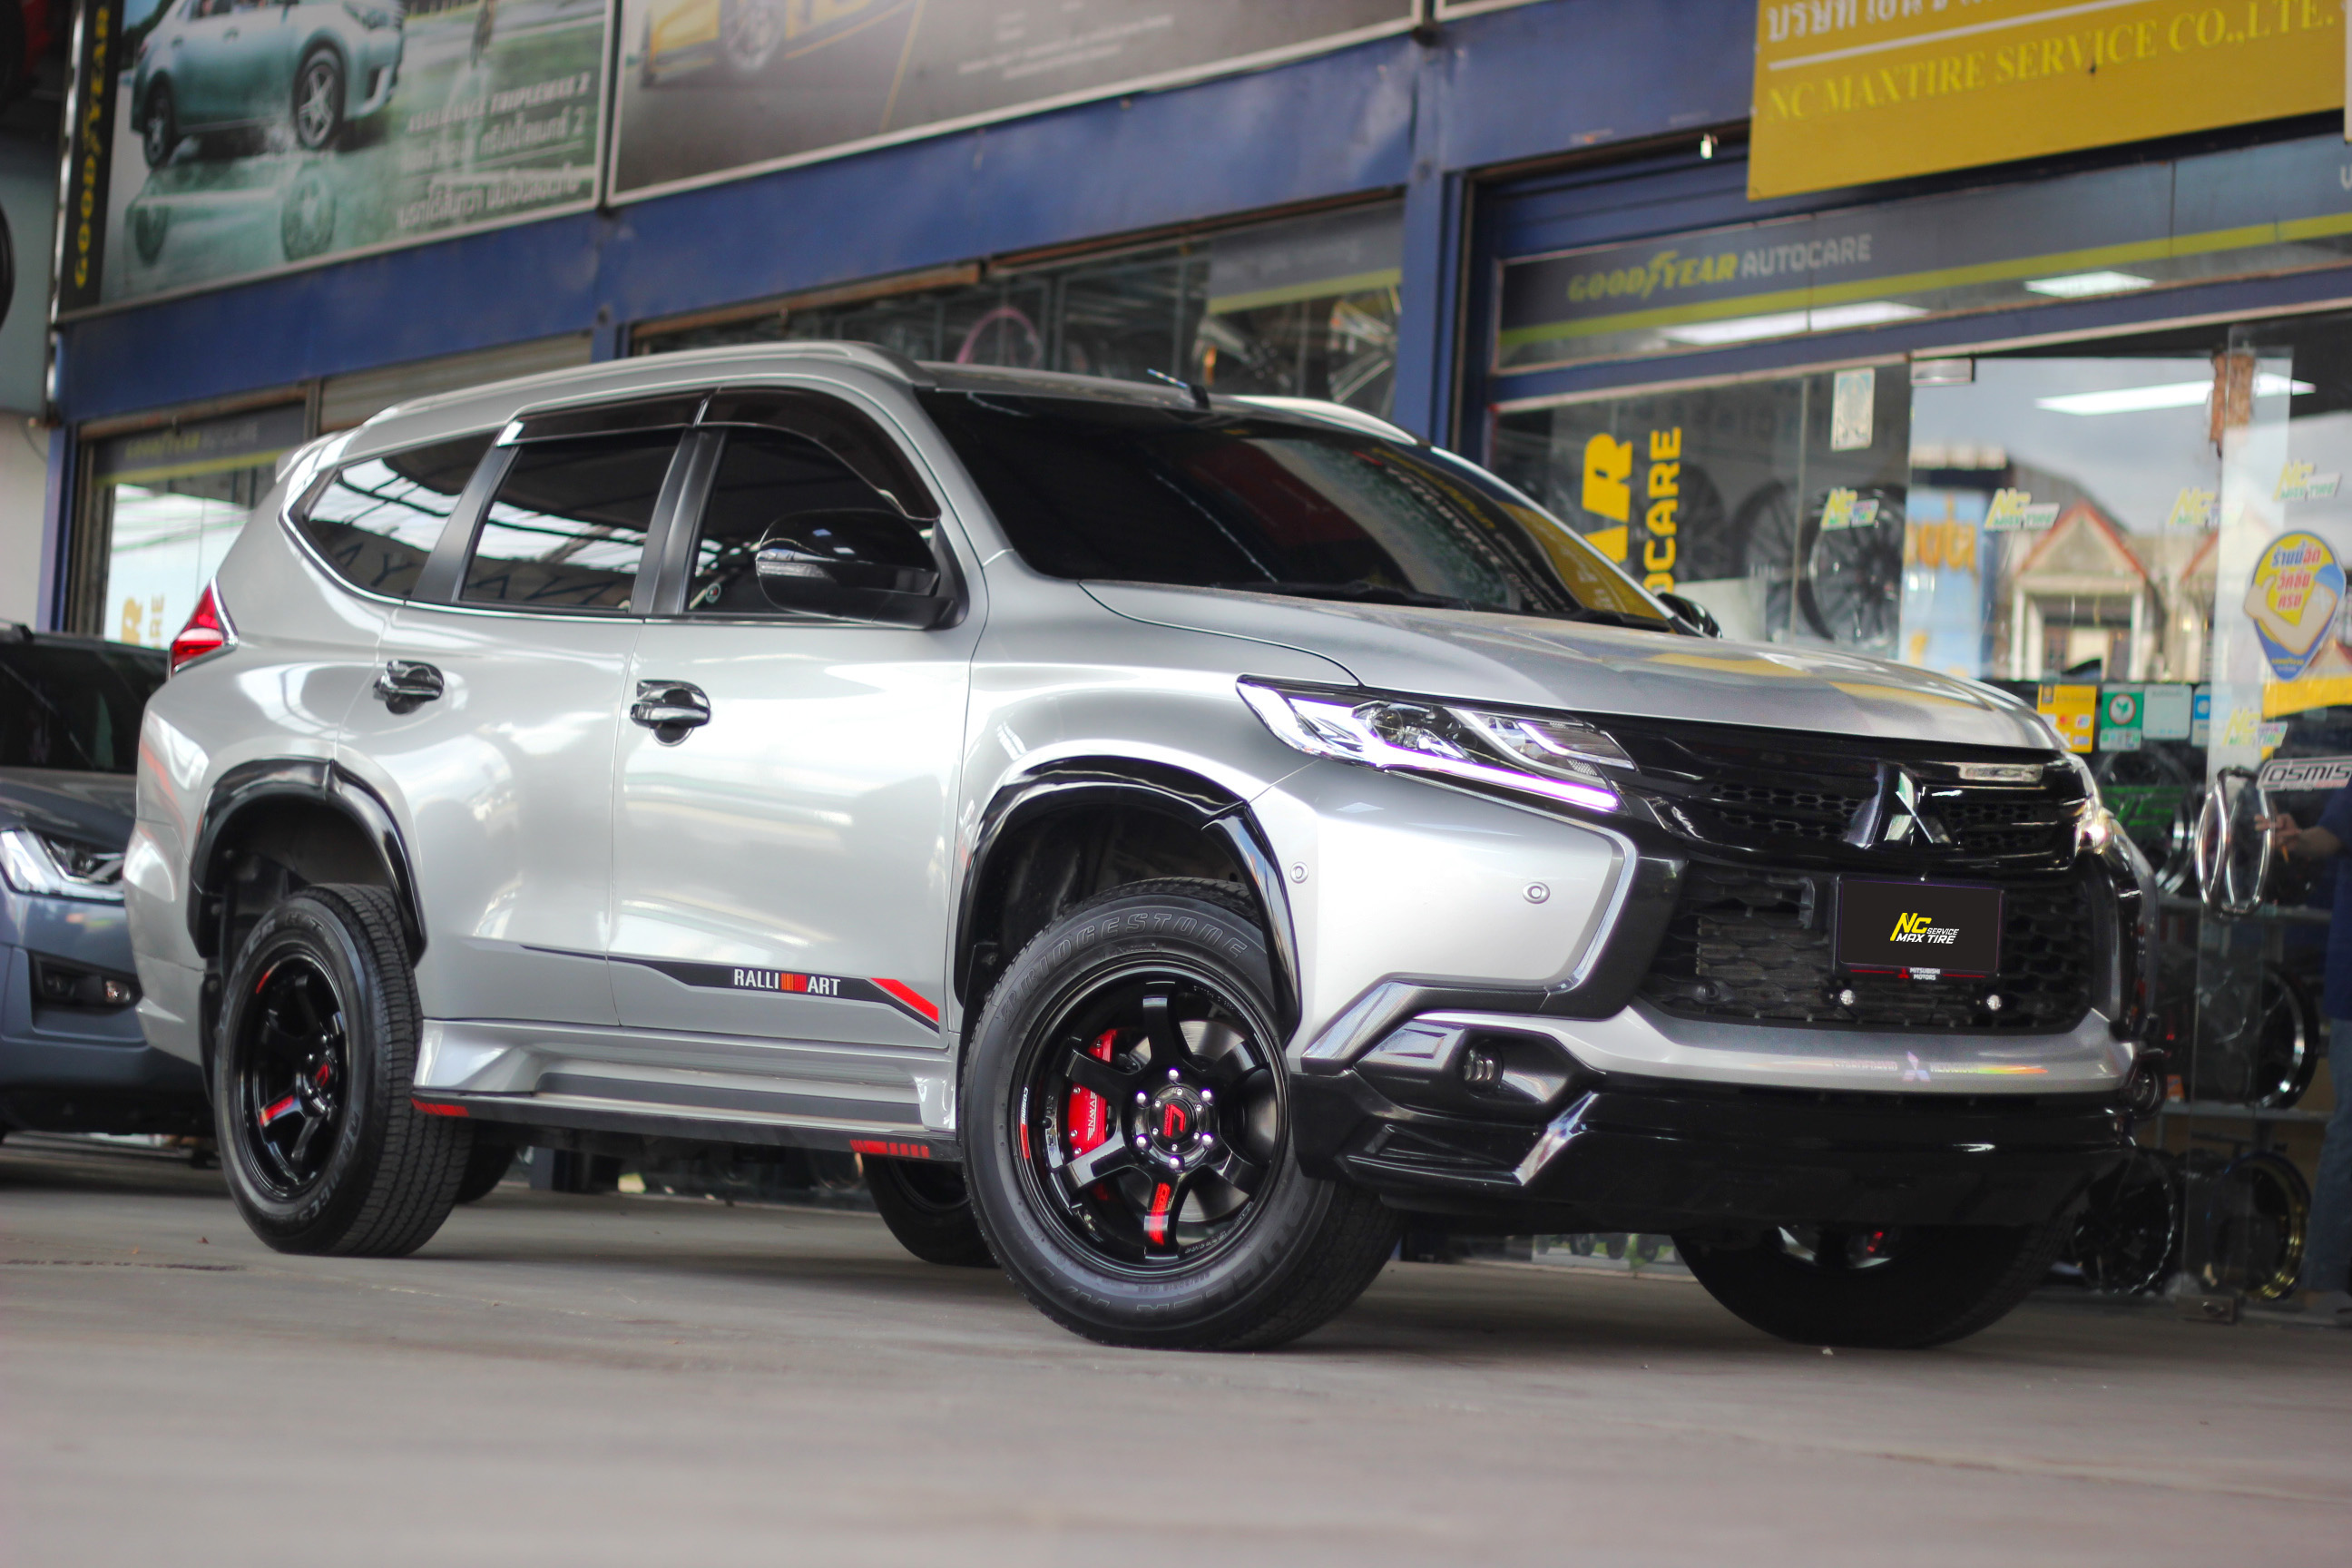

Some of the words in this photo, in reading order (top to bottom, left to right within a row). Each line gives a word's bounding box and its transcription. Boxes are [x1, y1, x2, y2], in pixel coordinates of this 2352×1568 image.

[1769, 82, 1815, 121] NC
[1823, 51, 1987, 112] MAXTIRE
[1997, 20, 2157, 84] SERVICE
[1567, 250, 1739, 302] GOODYEAR
[1740, 233, 1873, 278] AUTOCARE
[1984, 488, 2032, 529] NC
[1890, 913, 1932, 941] NC
[1926, 927, 1959, 936] SERVICE
[1896, 933, 1925, 943] MAX
[1926, 935, 1955, 944] TIRE
[996, 912, 1249, 1029] BRIDGESTONE
[1021, 1085, 1029, 1126] COSMIS
